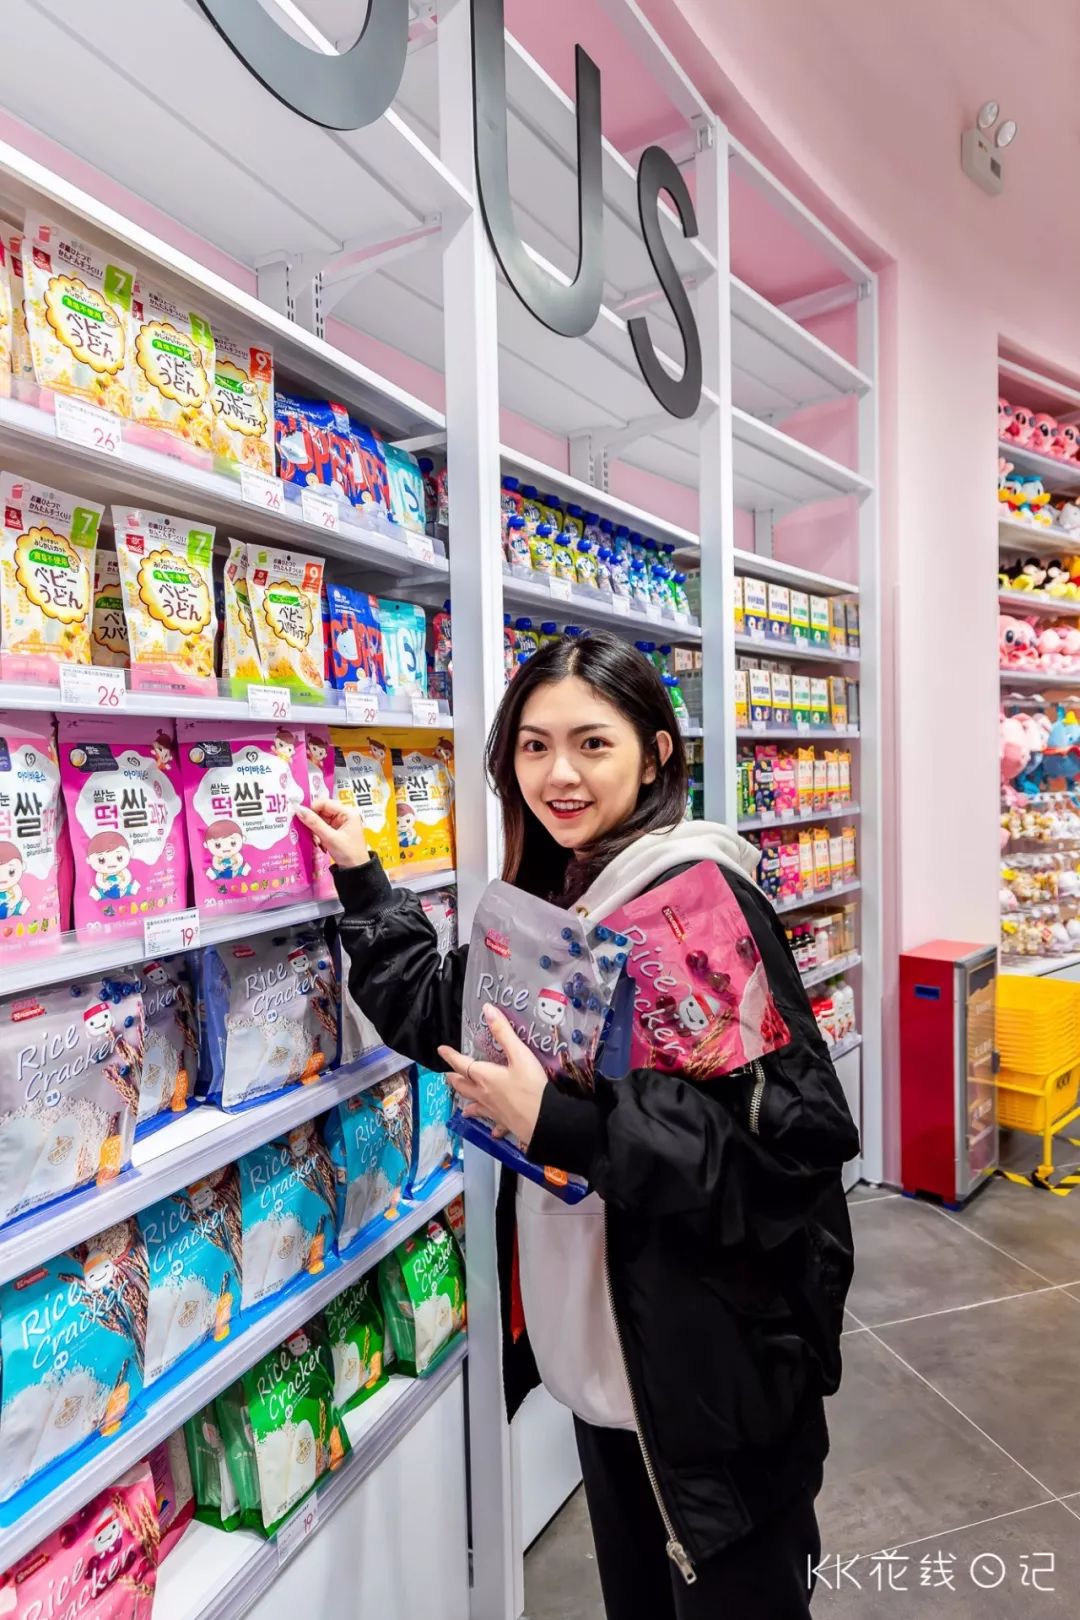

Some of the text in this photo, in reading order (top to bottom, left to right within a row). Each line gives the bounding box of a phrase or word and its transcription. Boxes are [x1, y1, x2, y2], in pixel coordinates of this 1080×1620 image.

[114, 271, 126, 296] 7
[66, 312, 113, 340] ベビー
[156, 352, 195, 377] ベビー
[255, 351, 268, 371] 9
[159, 367, 200, 398] うどん
[217, 389, 253, 408] ベビー
[93, 427, 116, 452] 26
[264, 490, 281, 511] 26
[80, 512, 94, 535] 7
[194, 534, 208, 555] 7
[34, 567, 78, 589] ベビー
[309, 565, 319, 584] 9
[39, 584, 83, 610] うどん
[158, 583, 198, 602] ベビー
[162, 599, 202, 622] うどん
[278, 606, 303, 624] ベビー
[97, 685, 120, 707] 26
[271, 700, 287, 719] 26
[180, 927, 194, 948] 19
[244, 962, 287, 999] Rice
[251, 973, 319, 1016] Cracker
[476, 972, 530, 1012] Rice
[478, 1009, 568, 1057] Ccker
[17, 1023, 80, 1081] Rice
[25, 1033, 124, 1101] Cracker
[355, 1108, 384, 1150] Rice
[249, 1147, 291, 1193] Rice
[259, 1153, 320, 1210] Cracker
[142, 1201, 191, 1250] Rice
[153, 1203, 229, 1273] Cracker
[412, 1240, 436, 1283] Rice
[421, 1236, 453, 1293] Cracker
[19, 1279, 83, 1350] Rice
[32, 1279, 130, 1370] Cracker
[256, 1350, 291, 1406] Rice
[268, 1345, 323, 1421] Cracker
[303, 1511, 314, 1534] 19
